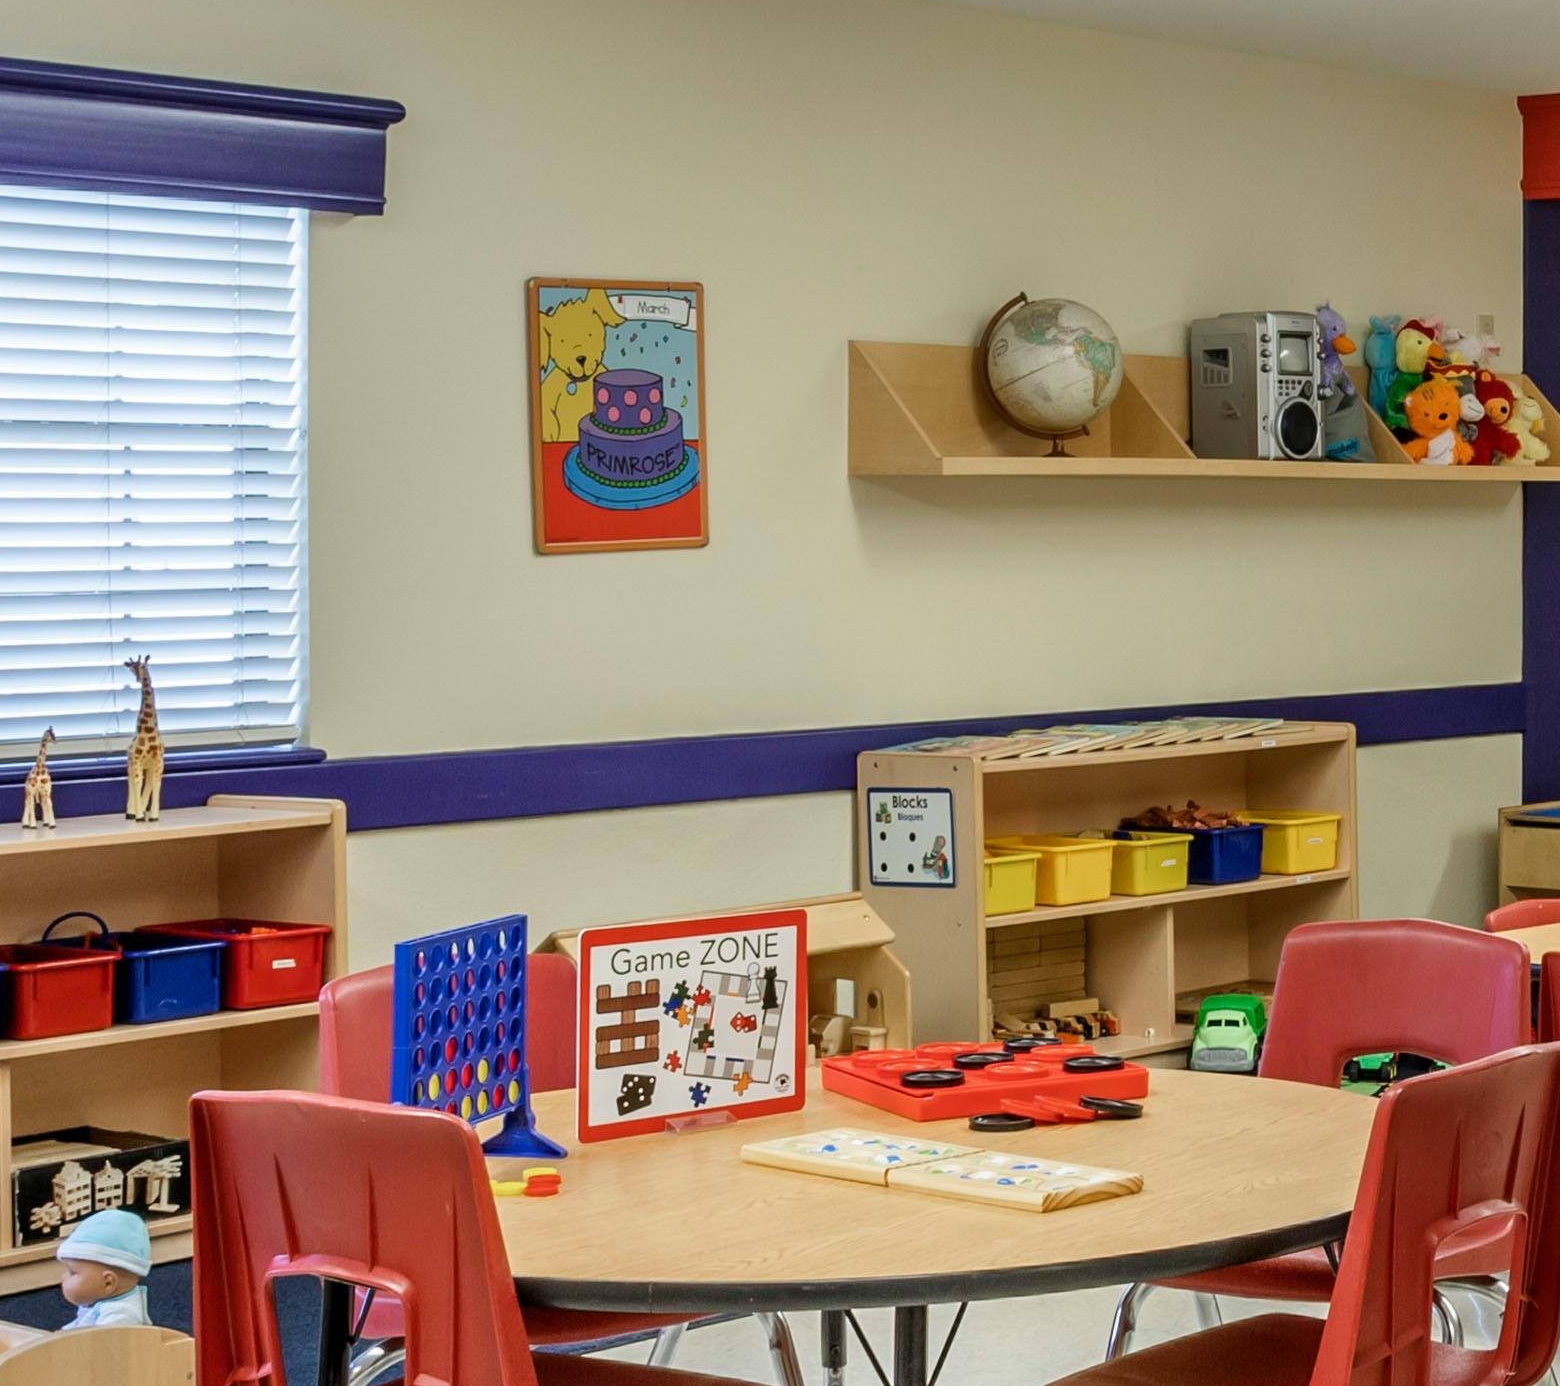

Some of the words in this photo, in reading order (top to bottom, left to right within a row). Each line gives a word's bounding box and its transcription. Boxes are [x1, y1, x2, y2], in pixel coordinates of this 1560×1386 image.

[637, 301, 671, 315] March
[587, 443, 675, 475] PRIMROSE
[892, 795, 928, 809] Blocks
[898, 813, 924, 822] Bloques
[611, 948, 691, 975] Game
[700, 933, 780, 965] ZONE
